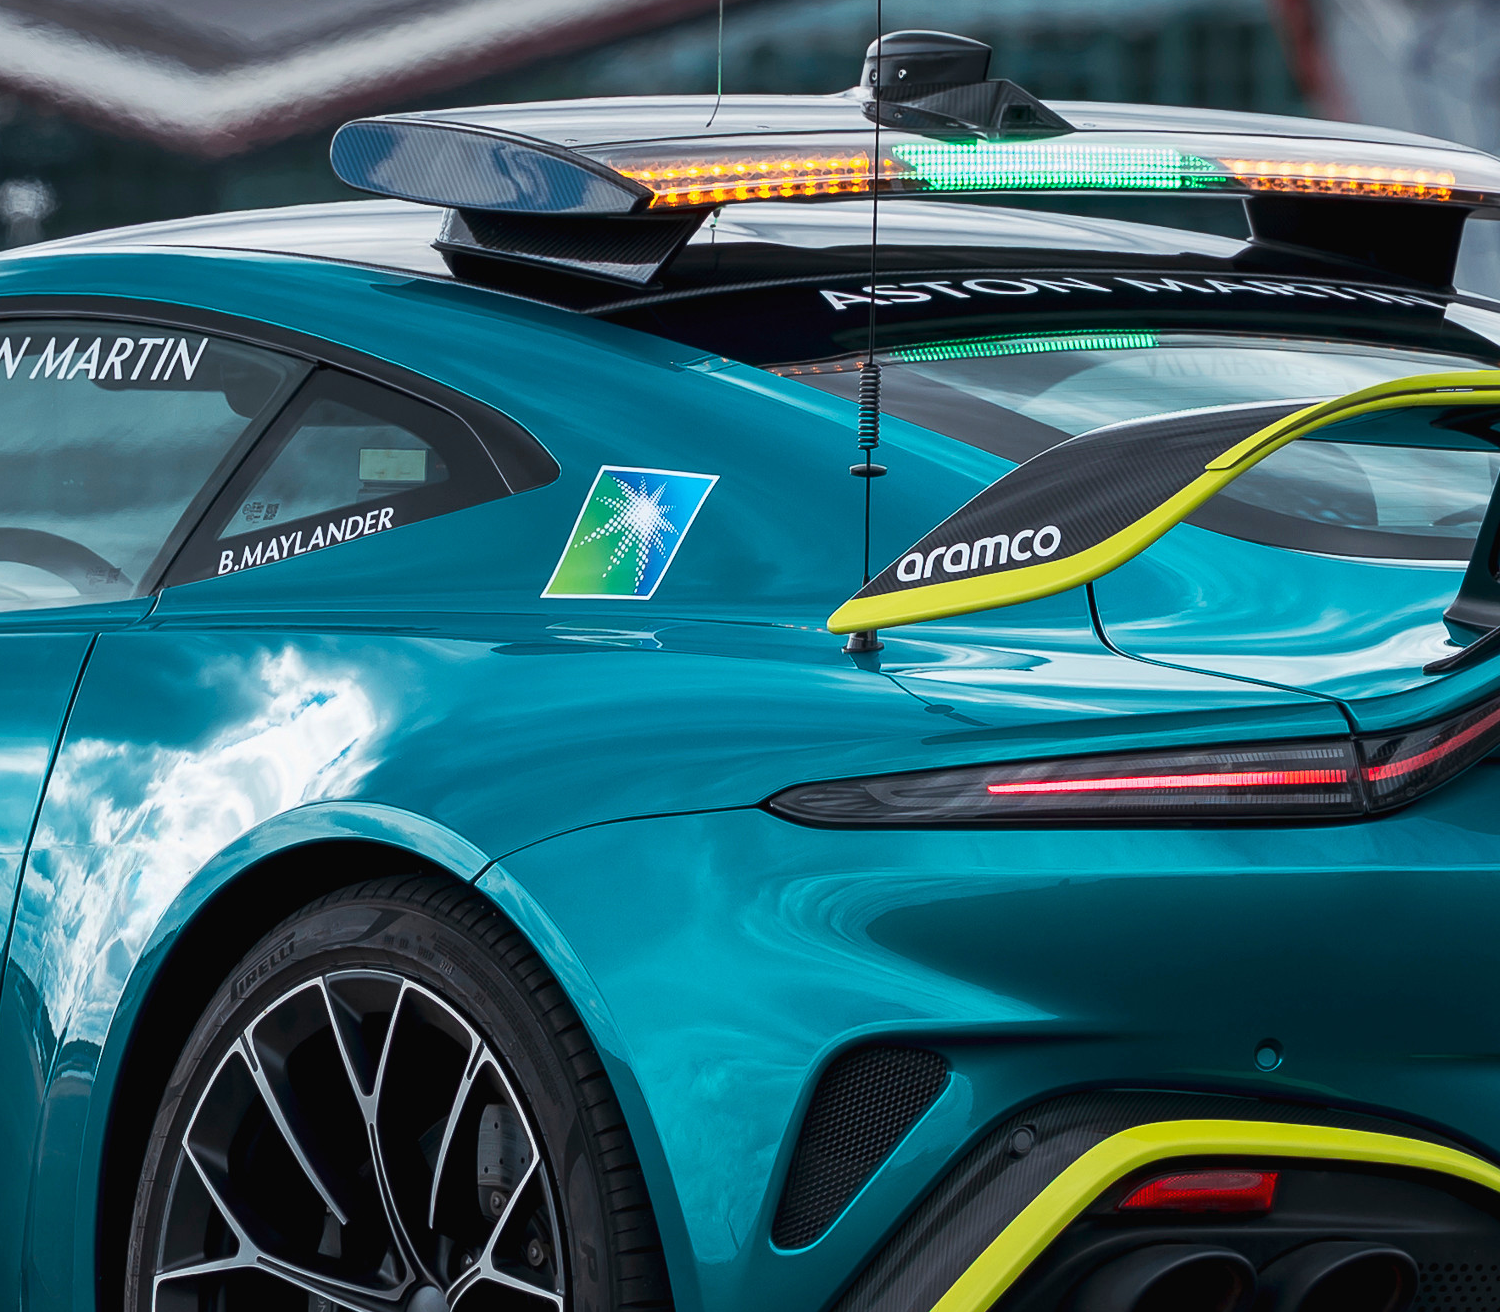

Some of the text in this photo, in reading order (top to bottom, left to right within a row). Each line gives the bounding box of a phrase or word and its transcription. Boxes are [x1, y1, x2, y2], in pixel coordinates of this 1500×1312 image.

[819, 277, 1448, 311] ASTON MARTIN
[29, 336, 209, 381] MARTIN
[217, 506, 395, 576] B.MAYLANDER
[896, 524, 1062, 583] aramco
